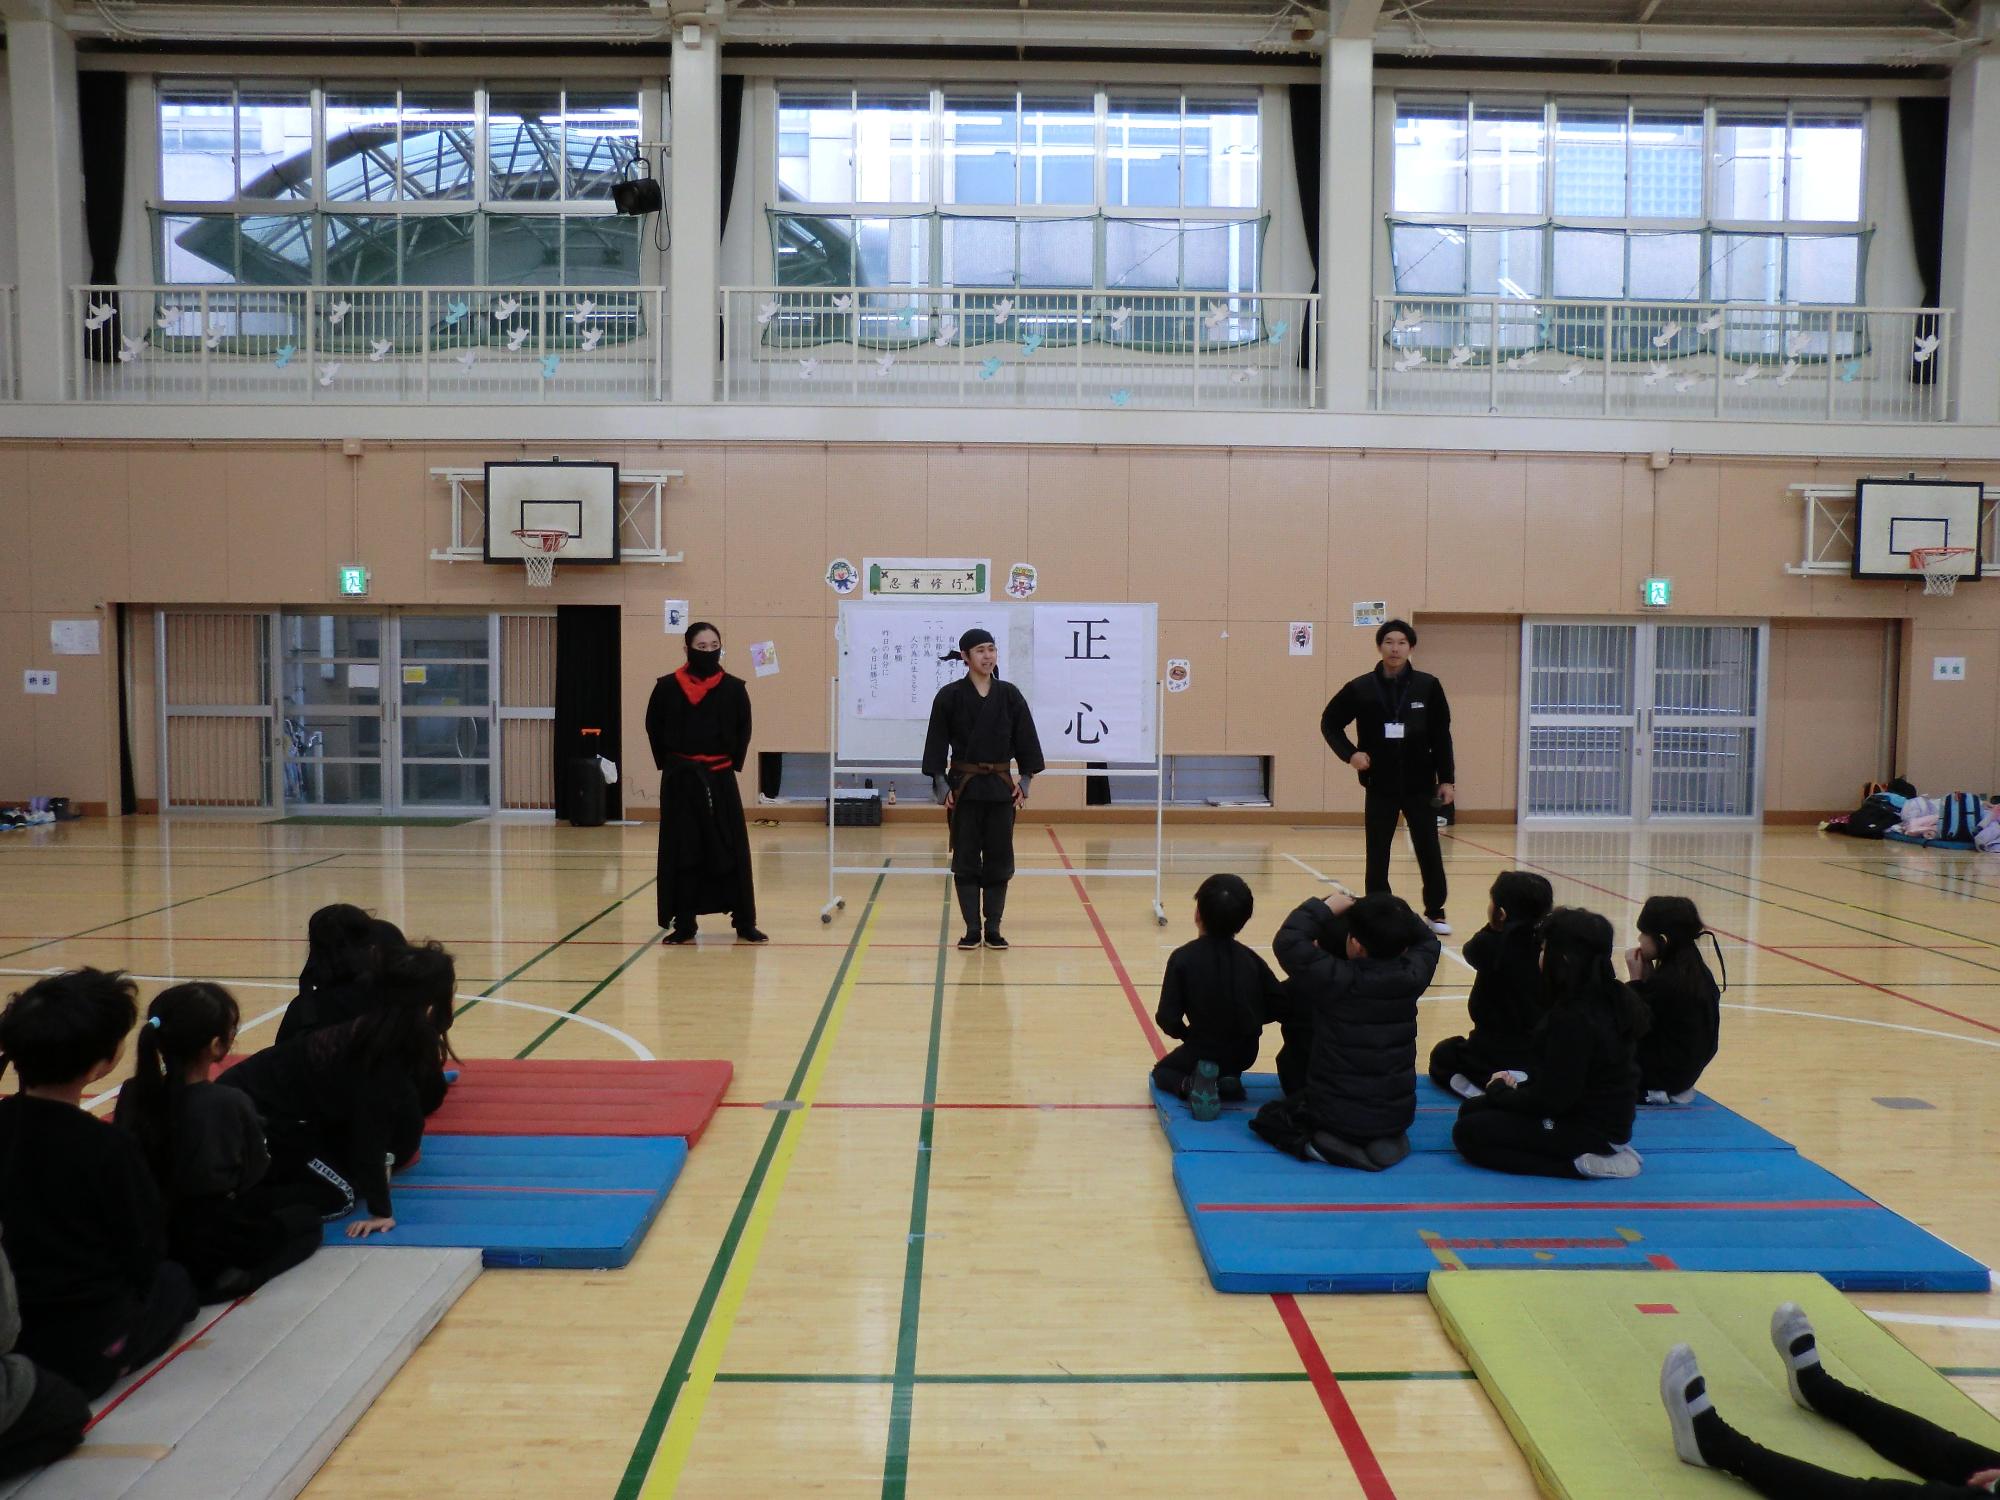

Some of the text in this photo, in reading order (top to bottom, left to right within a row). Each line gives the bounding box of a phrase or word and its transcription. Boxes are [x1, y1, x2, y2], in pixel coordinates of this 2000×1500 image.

[889, 577, 963, 590] 忍者修行
[1064, 617, 1111, 745] 正心
